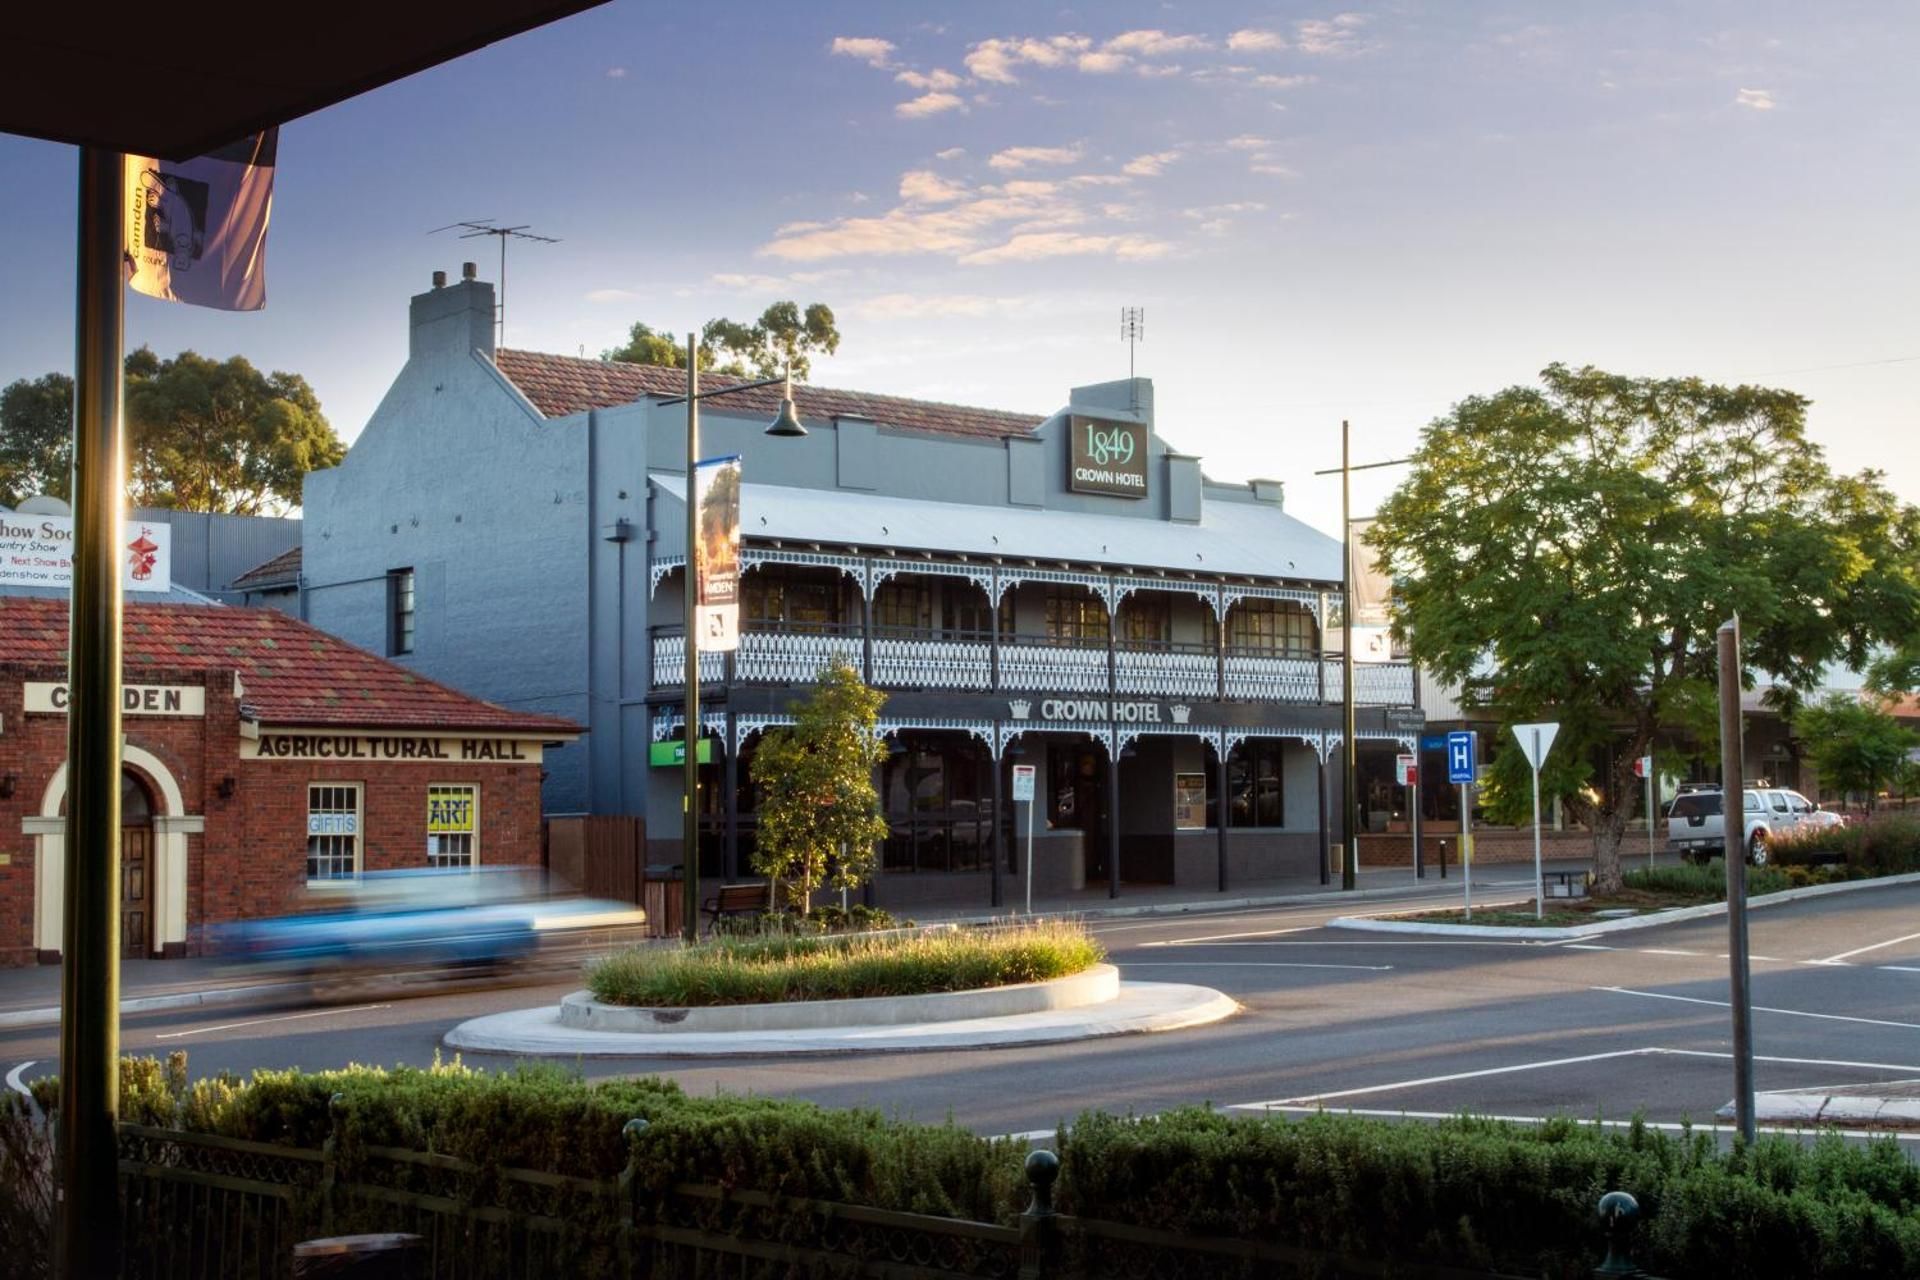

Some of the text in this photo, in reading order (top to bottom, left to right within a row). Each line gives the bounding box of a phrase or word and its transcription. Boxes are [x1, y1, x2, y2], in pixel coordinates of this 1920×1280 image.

[133, 187, 143, 258] camden
[1086, 424, 1134, 465] 1849
[1075, 467, 1145, 487] CROWN HOTEL
[33, 557, 57, 567] Show
[51, 687, 181, 711] CDEN
[1041, 700, 1162, 723] CROWN HOTEL
[257, 736, 526, 760] AGRICULTURAL HALL
[1454, 745, 1468, 769] H
[309, 816, 356, 833] GIFTS
[429, 800, 470, 825] ART
